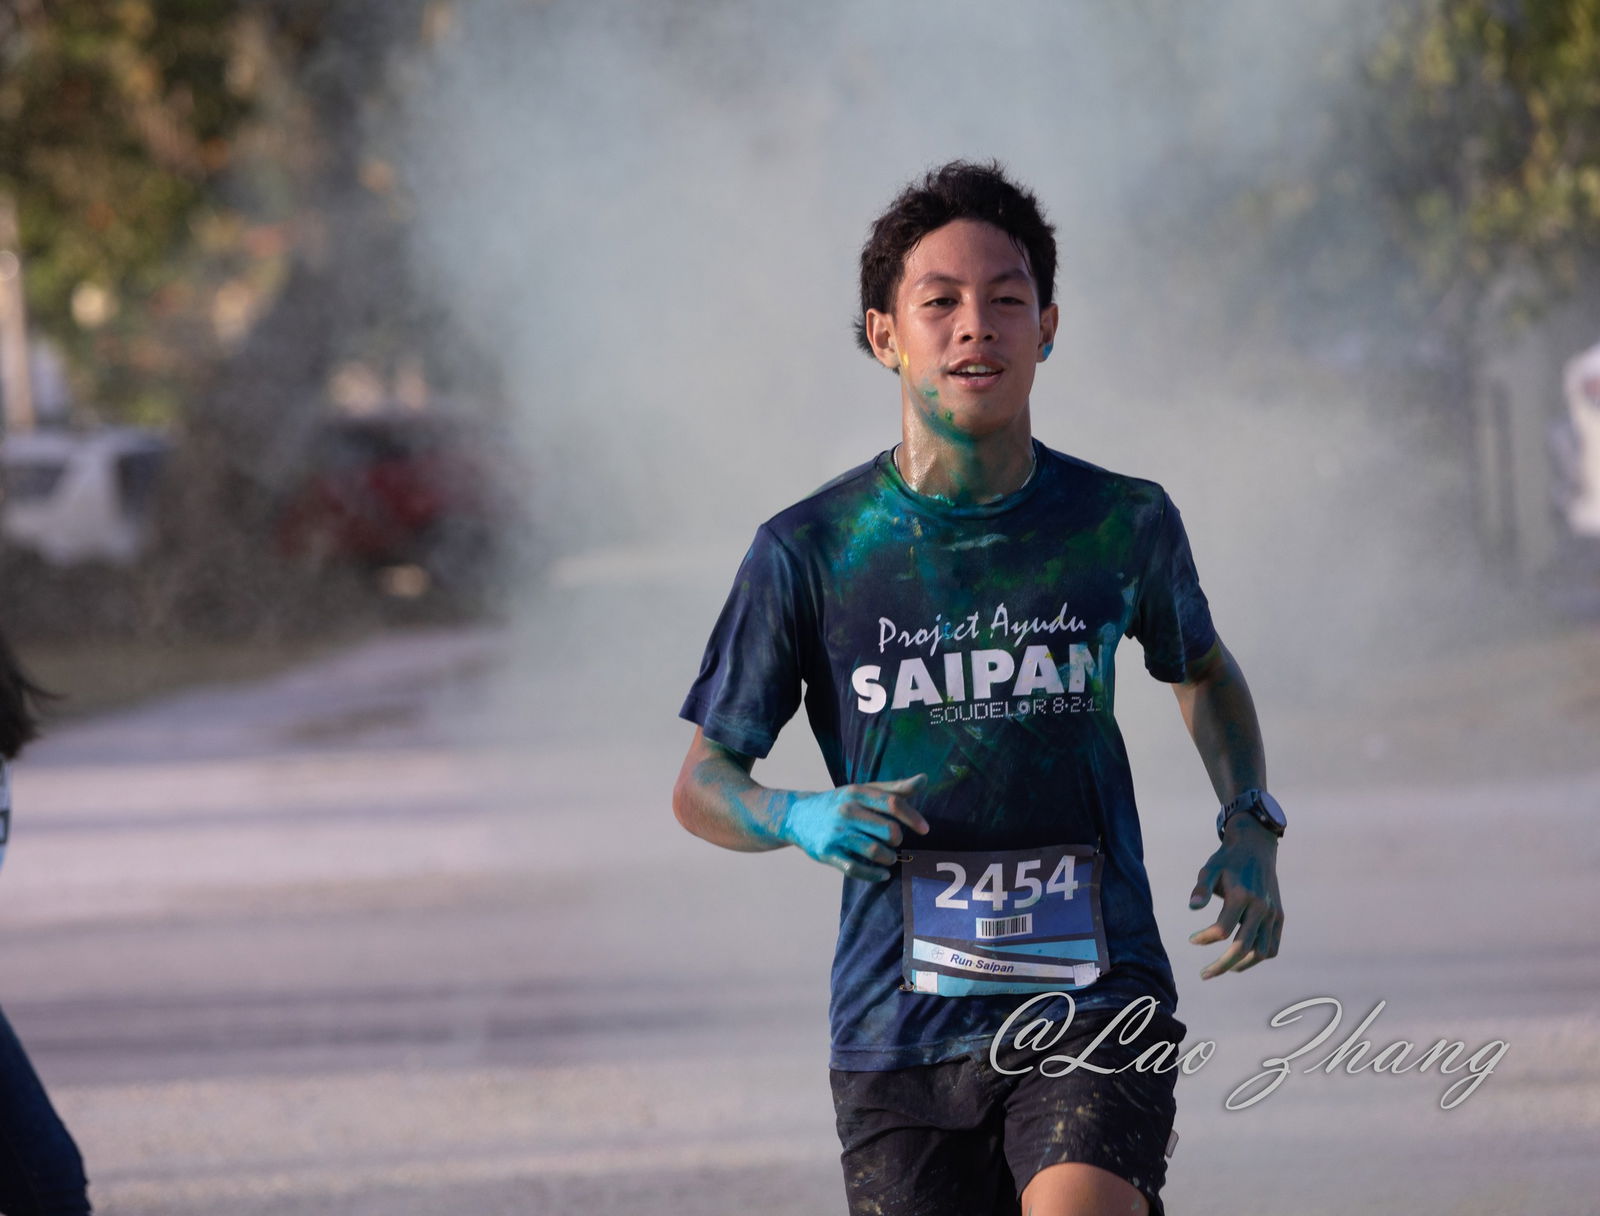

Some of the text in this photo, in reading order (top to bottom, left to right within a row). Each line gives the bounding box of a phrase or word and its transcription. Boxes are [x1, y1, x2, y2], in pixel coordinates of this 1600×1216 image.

[877, 601, 1087, 656] Project Ayudu
[851, 643, 1104, 714] SAIPAN
[935, 855, 1079, 911] 2454
[950, 953, 1015, 974] Run Saipan
